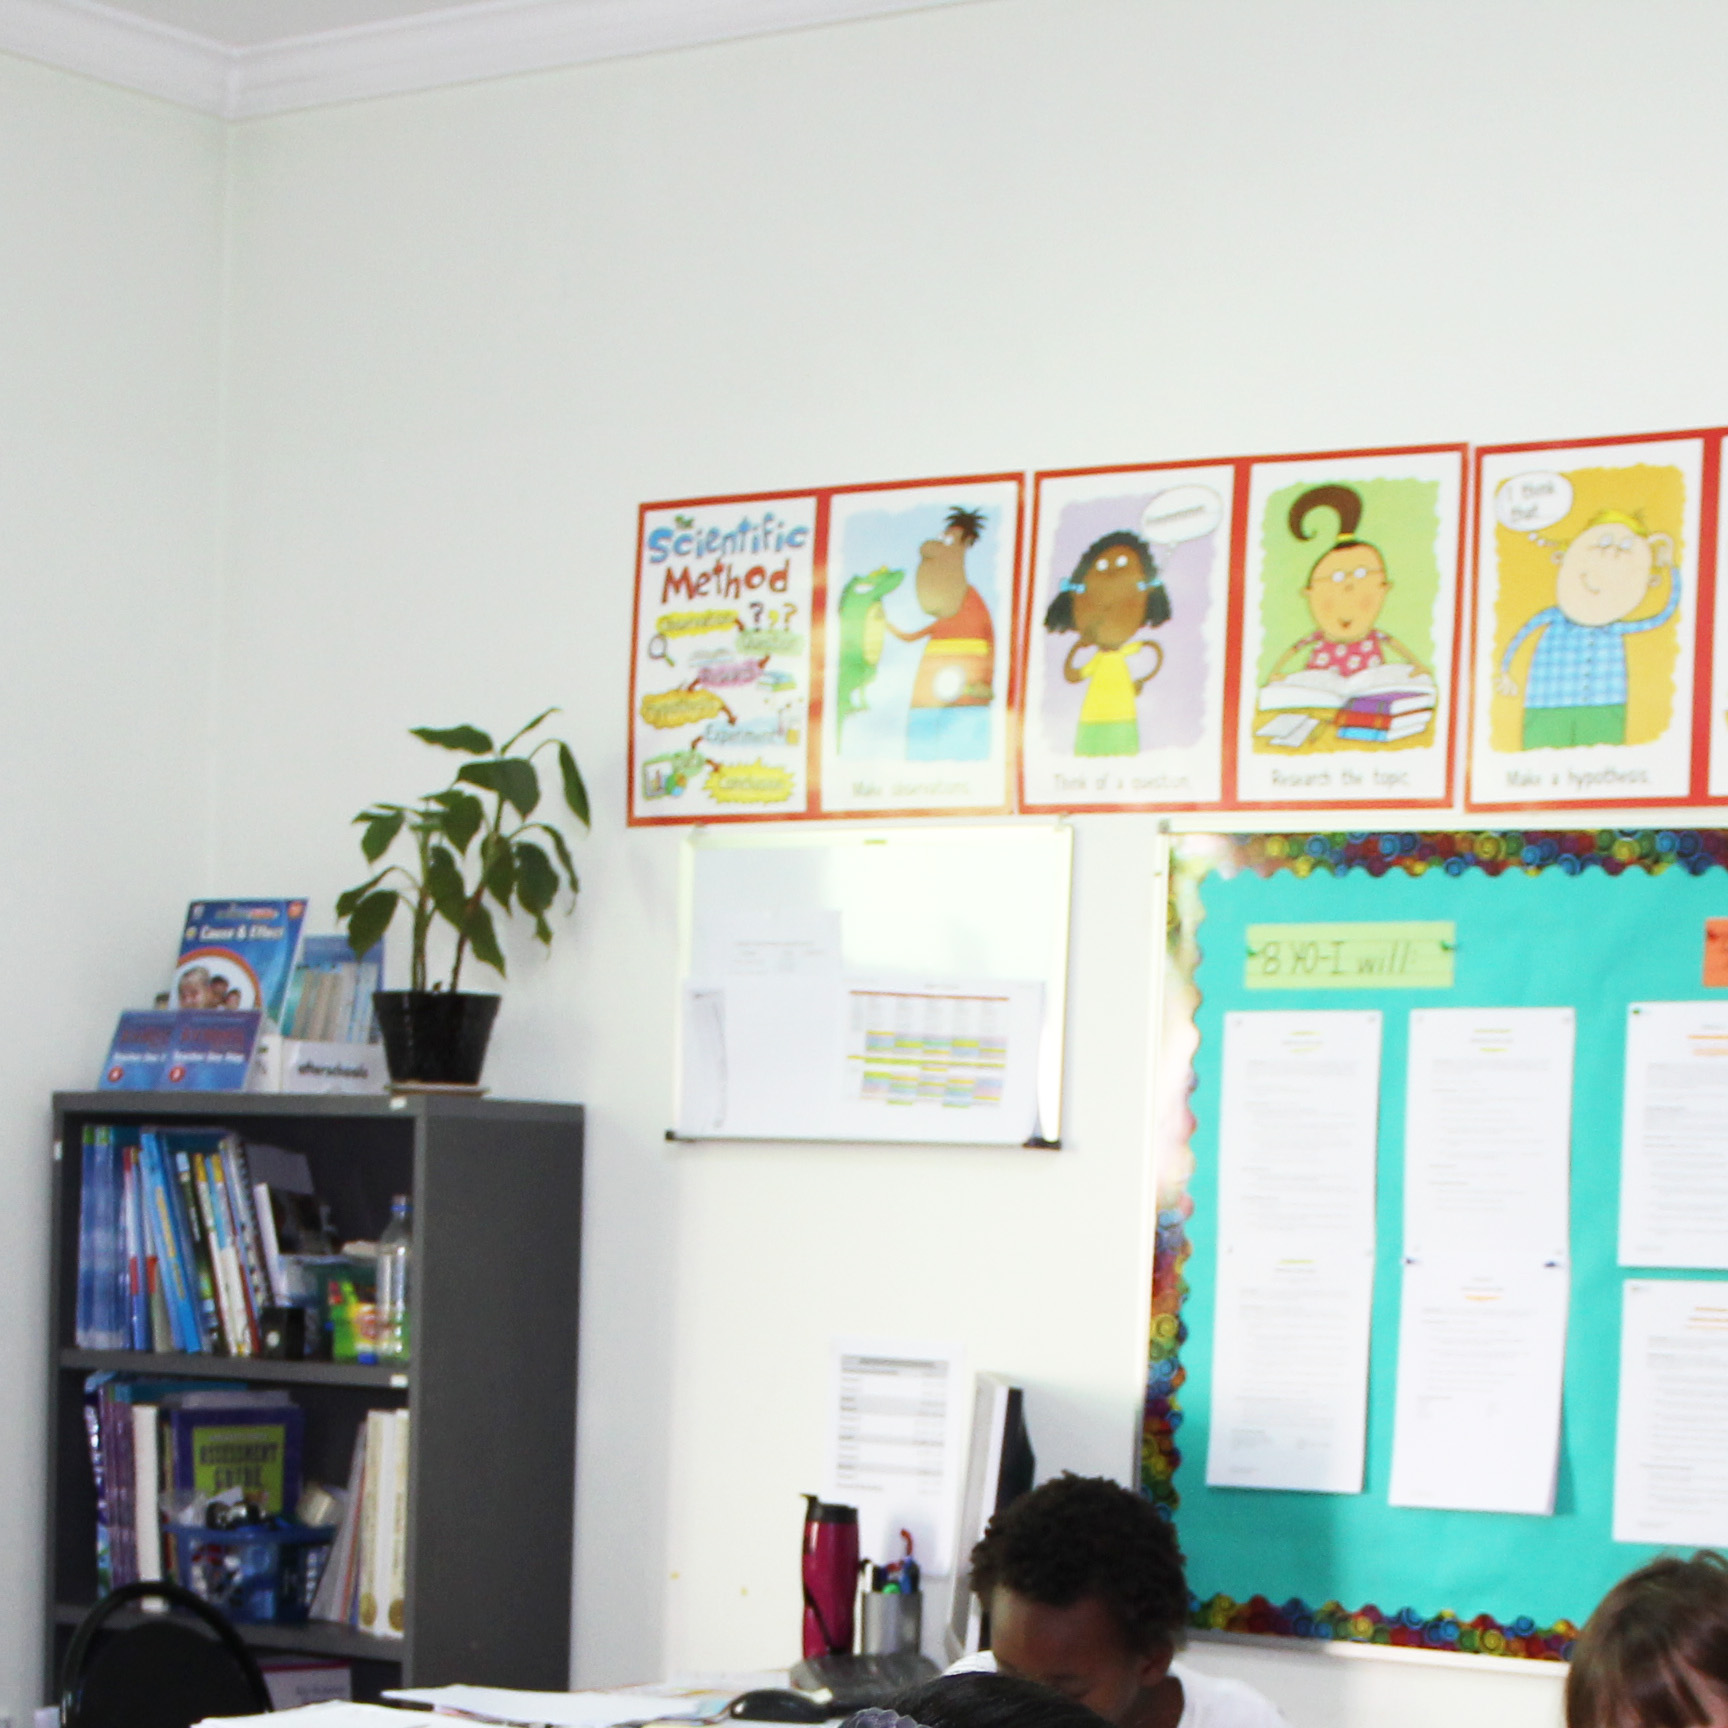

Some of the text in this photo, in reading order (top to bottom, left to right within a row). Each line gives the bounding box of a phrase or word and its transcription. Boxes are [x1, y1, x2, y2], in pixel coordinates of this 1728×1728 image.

[648, 511, 809, 564] Scientific
[661, 558, 790, 604] Method
[1270, 768, 1330, 788] Research
[1340, 766, 1363, 787] the
[1505, 768, 1540, 788] Make
[198, 924, 235, 941] Cause
[249, 924, 285, 940] Effect
[1261, 941, 1281, 976] 8
[199, 1441, 279, 1464] ASSESSMENT
